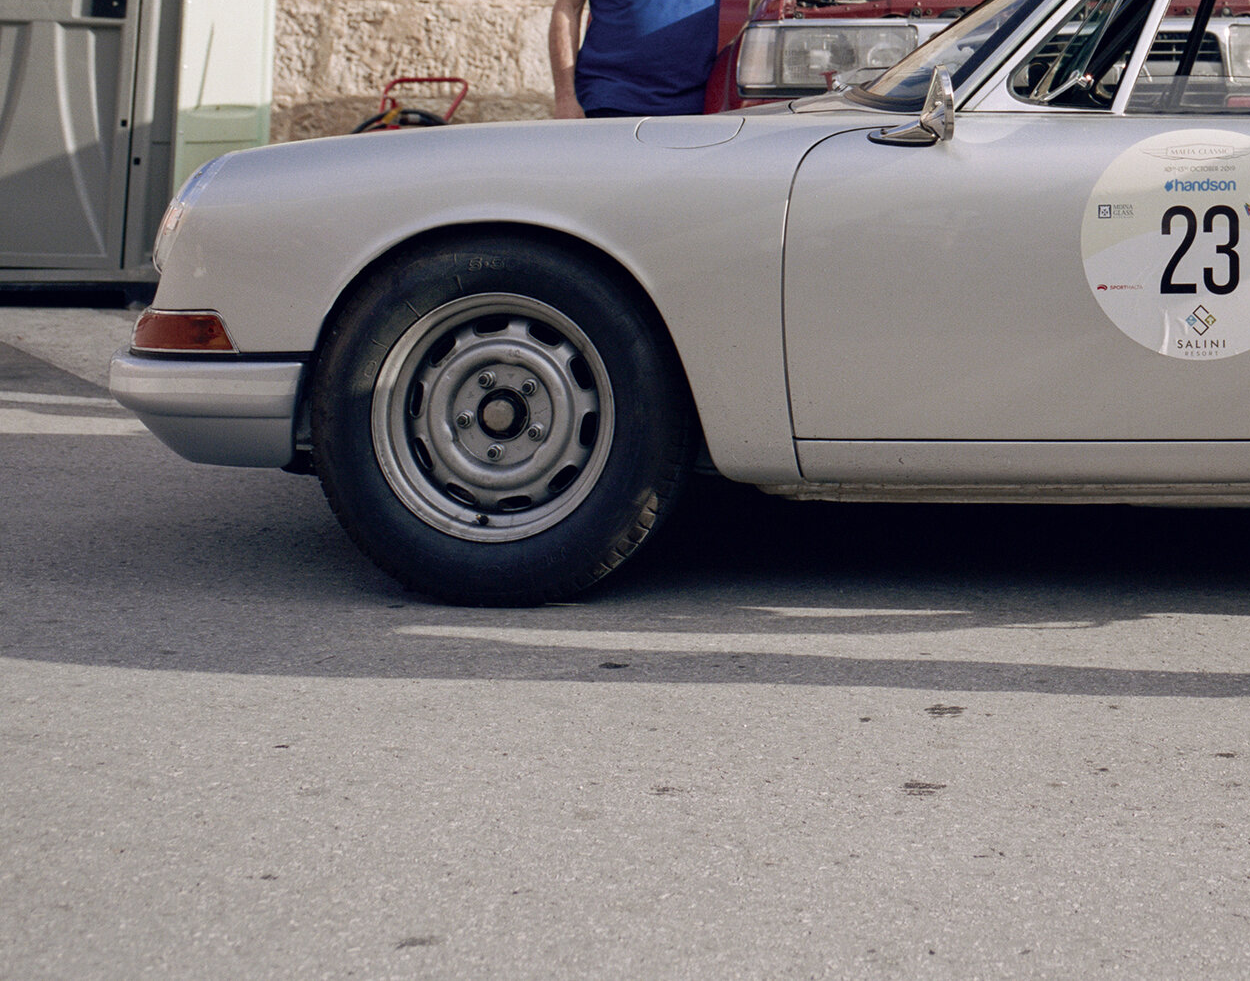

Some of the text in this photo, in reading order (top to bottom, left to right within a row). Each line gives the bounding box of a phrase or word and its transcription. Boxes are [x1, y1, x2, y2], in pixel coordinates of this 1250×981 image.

[1189, 165, 1219, 173] OCTOBER
[1174, 178, 1237, 192] handson
[1159, 204, 1241, 296] 23
[1177, 339, 1226, 349] SALINI
